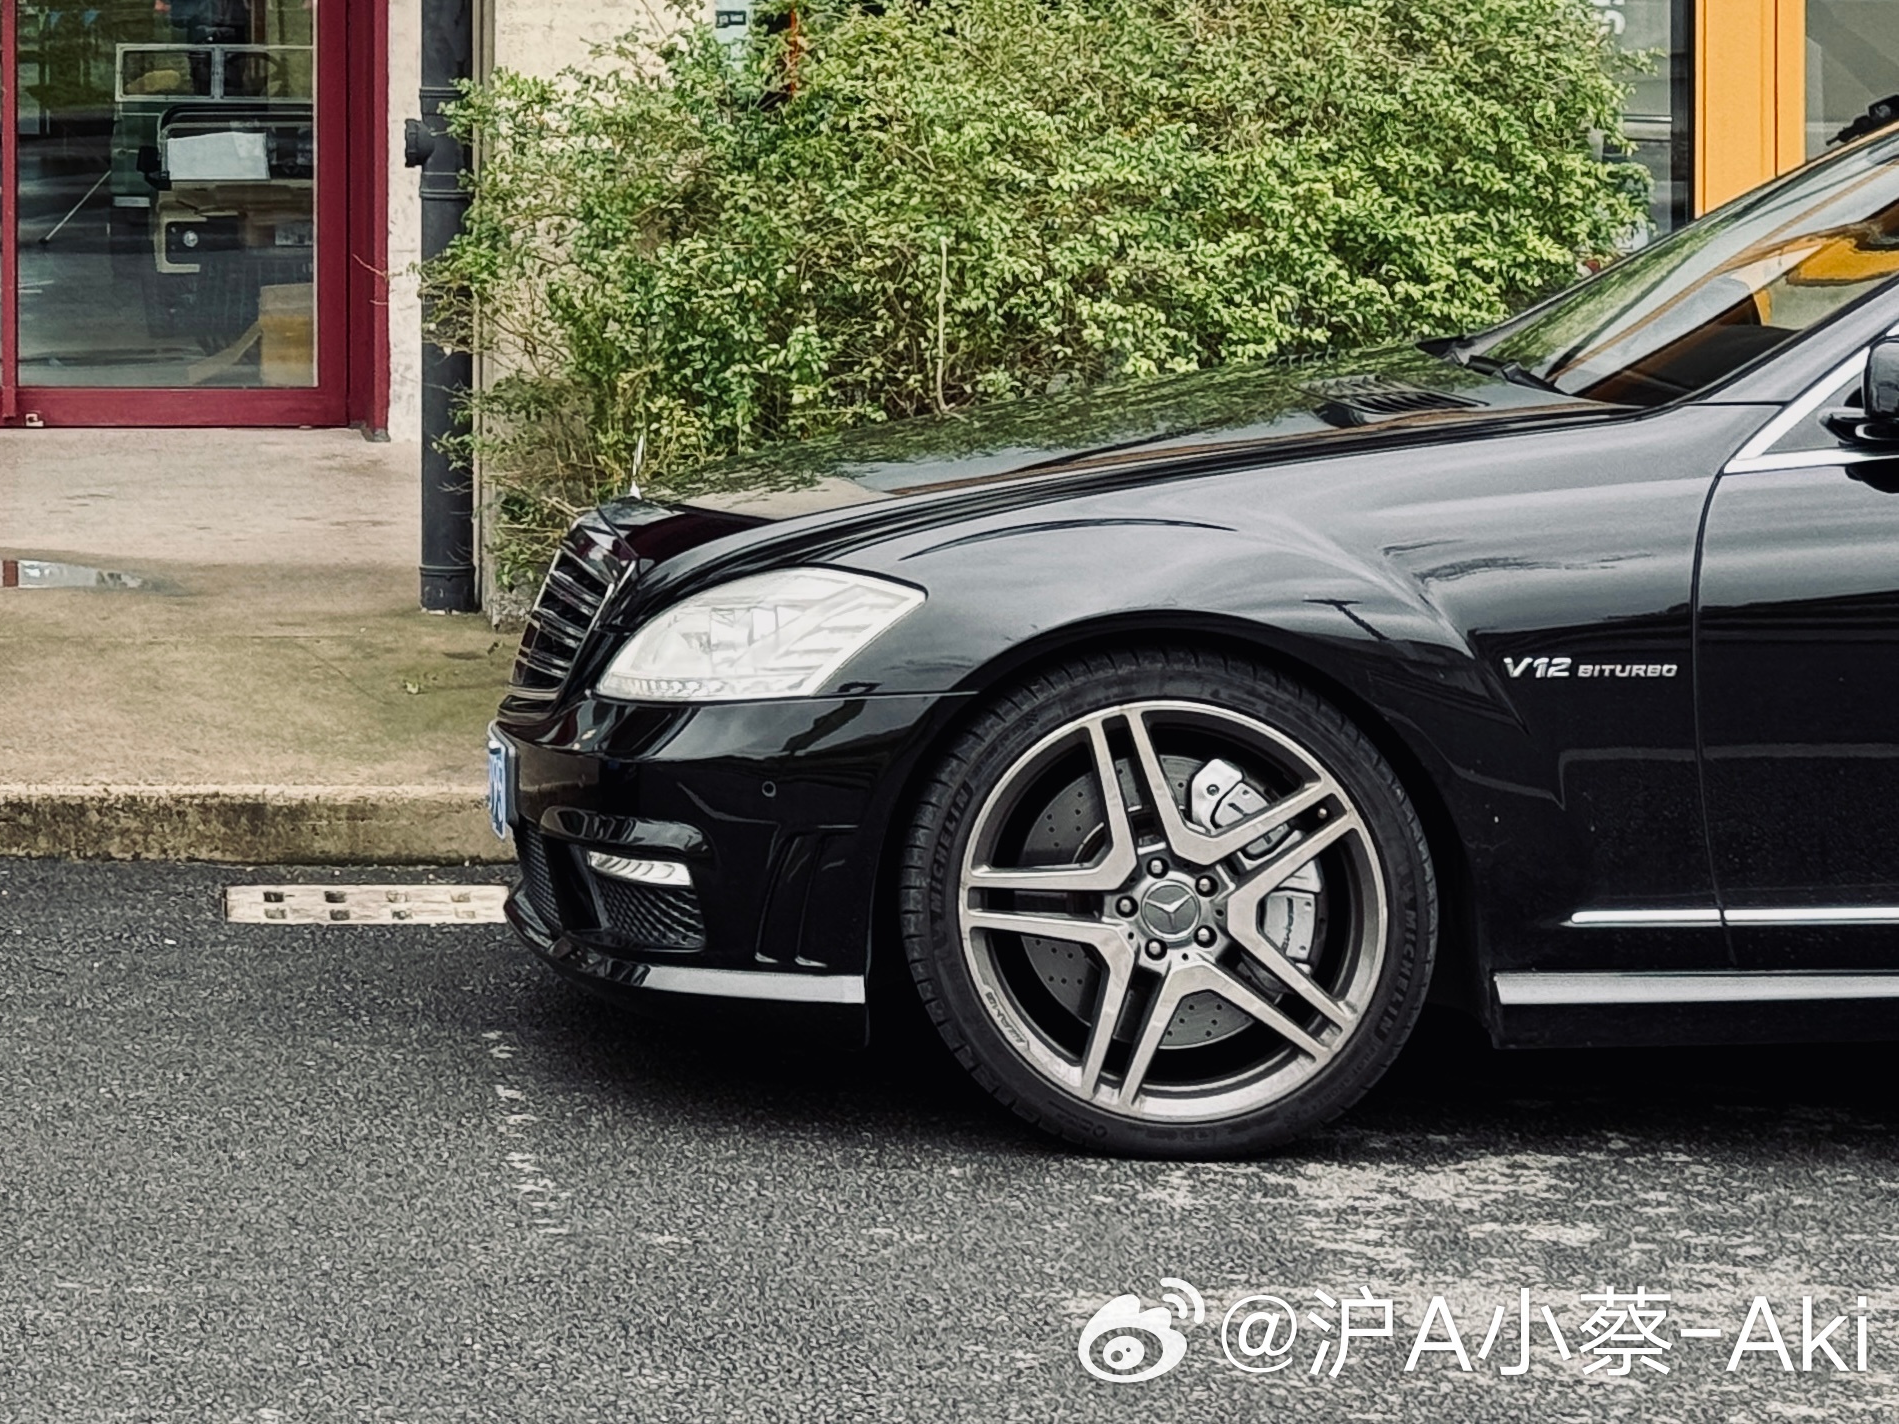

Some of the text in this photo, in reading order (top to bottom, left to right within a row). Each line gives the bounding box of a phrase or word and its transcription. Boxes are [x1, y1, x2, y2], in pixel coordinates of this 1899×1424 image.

[1503, 656, 1678, 679] V12 BITURBO
[930, 786, 971, 914] MICHELIN
[1377, 908, 1418, 1036] MICHELIN
